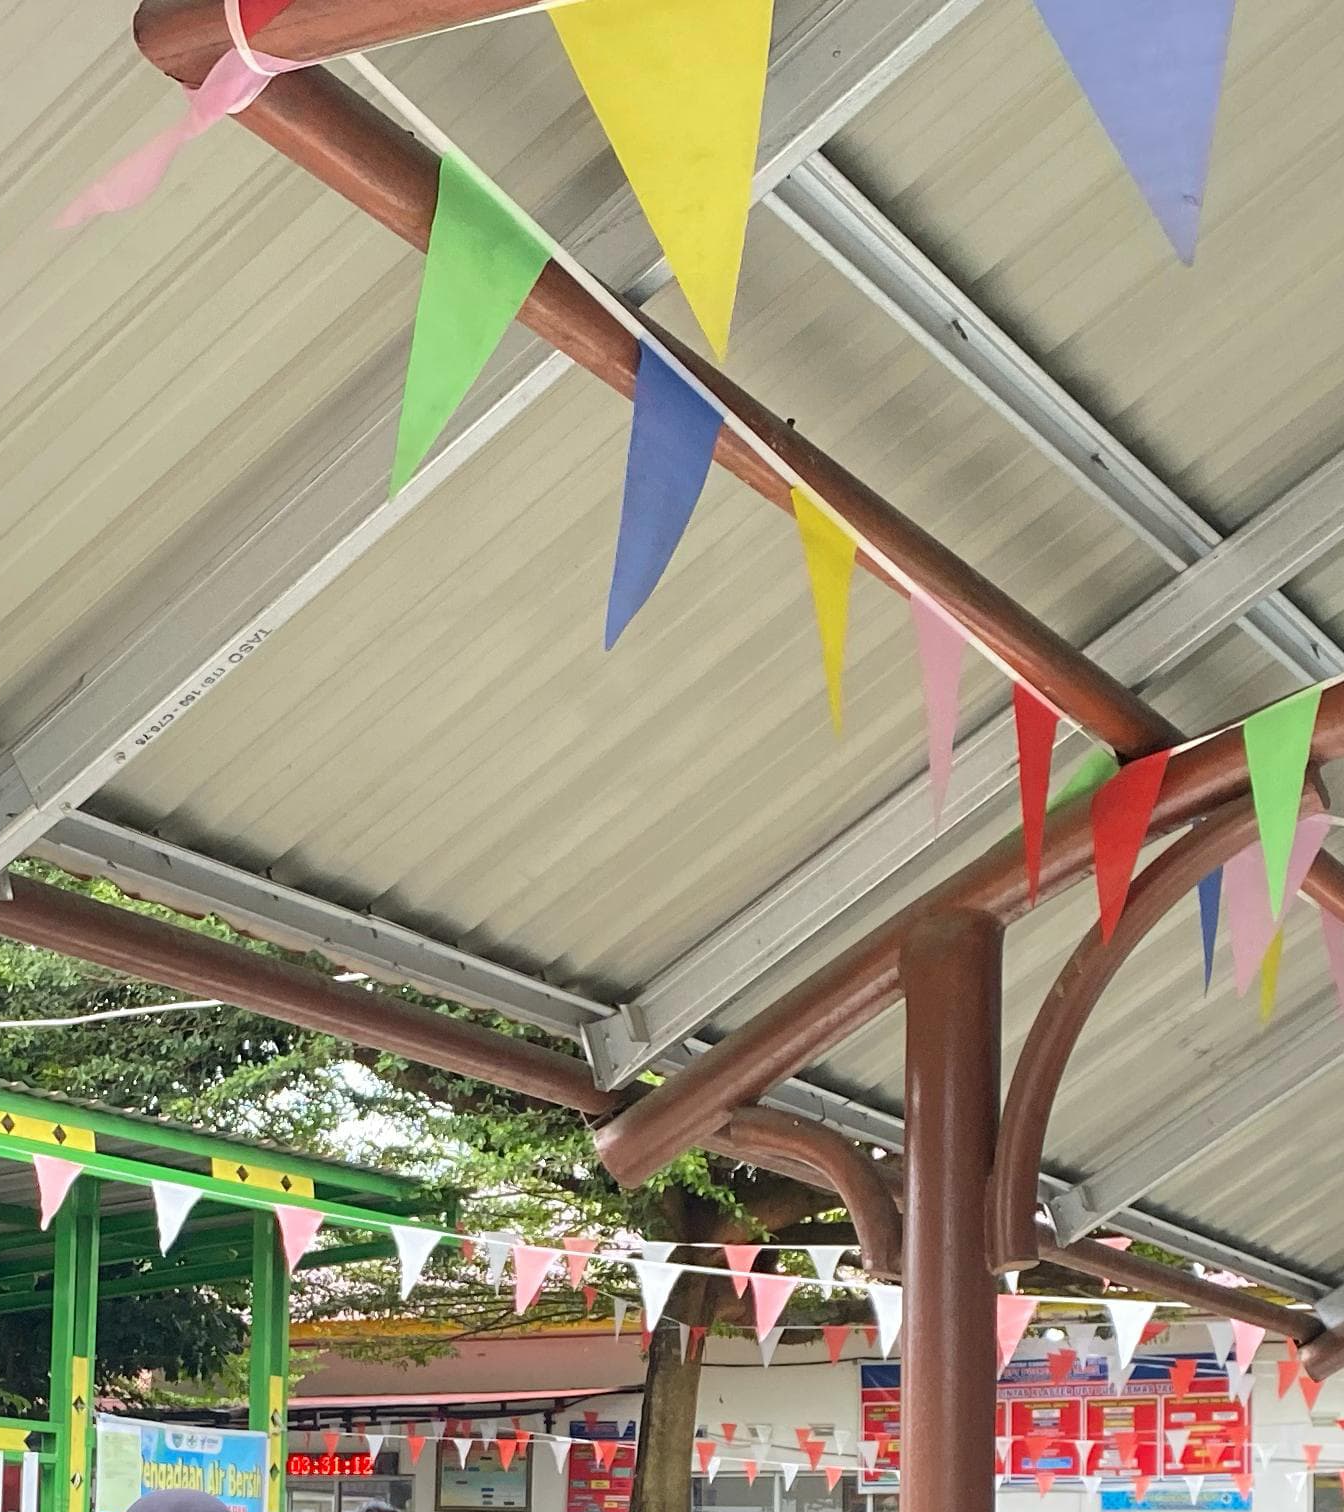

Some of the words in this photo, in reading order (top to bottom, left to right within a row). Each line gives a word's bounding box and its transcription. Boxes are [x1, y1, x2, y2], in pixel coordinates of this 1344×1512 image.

[228, 628, 273, 664] TASO
[208, 1460, 226, 1496] Air
[228, 1463, 263, 1499] Bersih
[289, 1455, 374, 1475] 03:31:12
